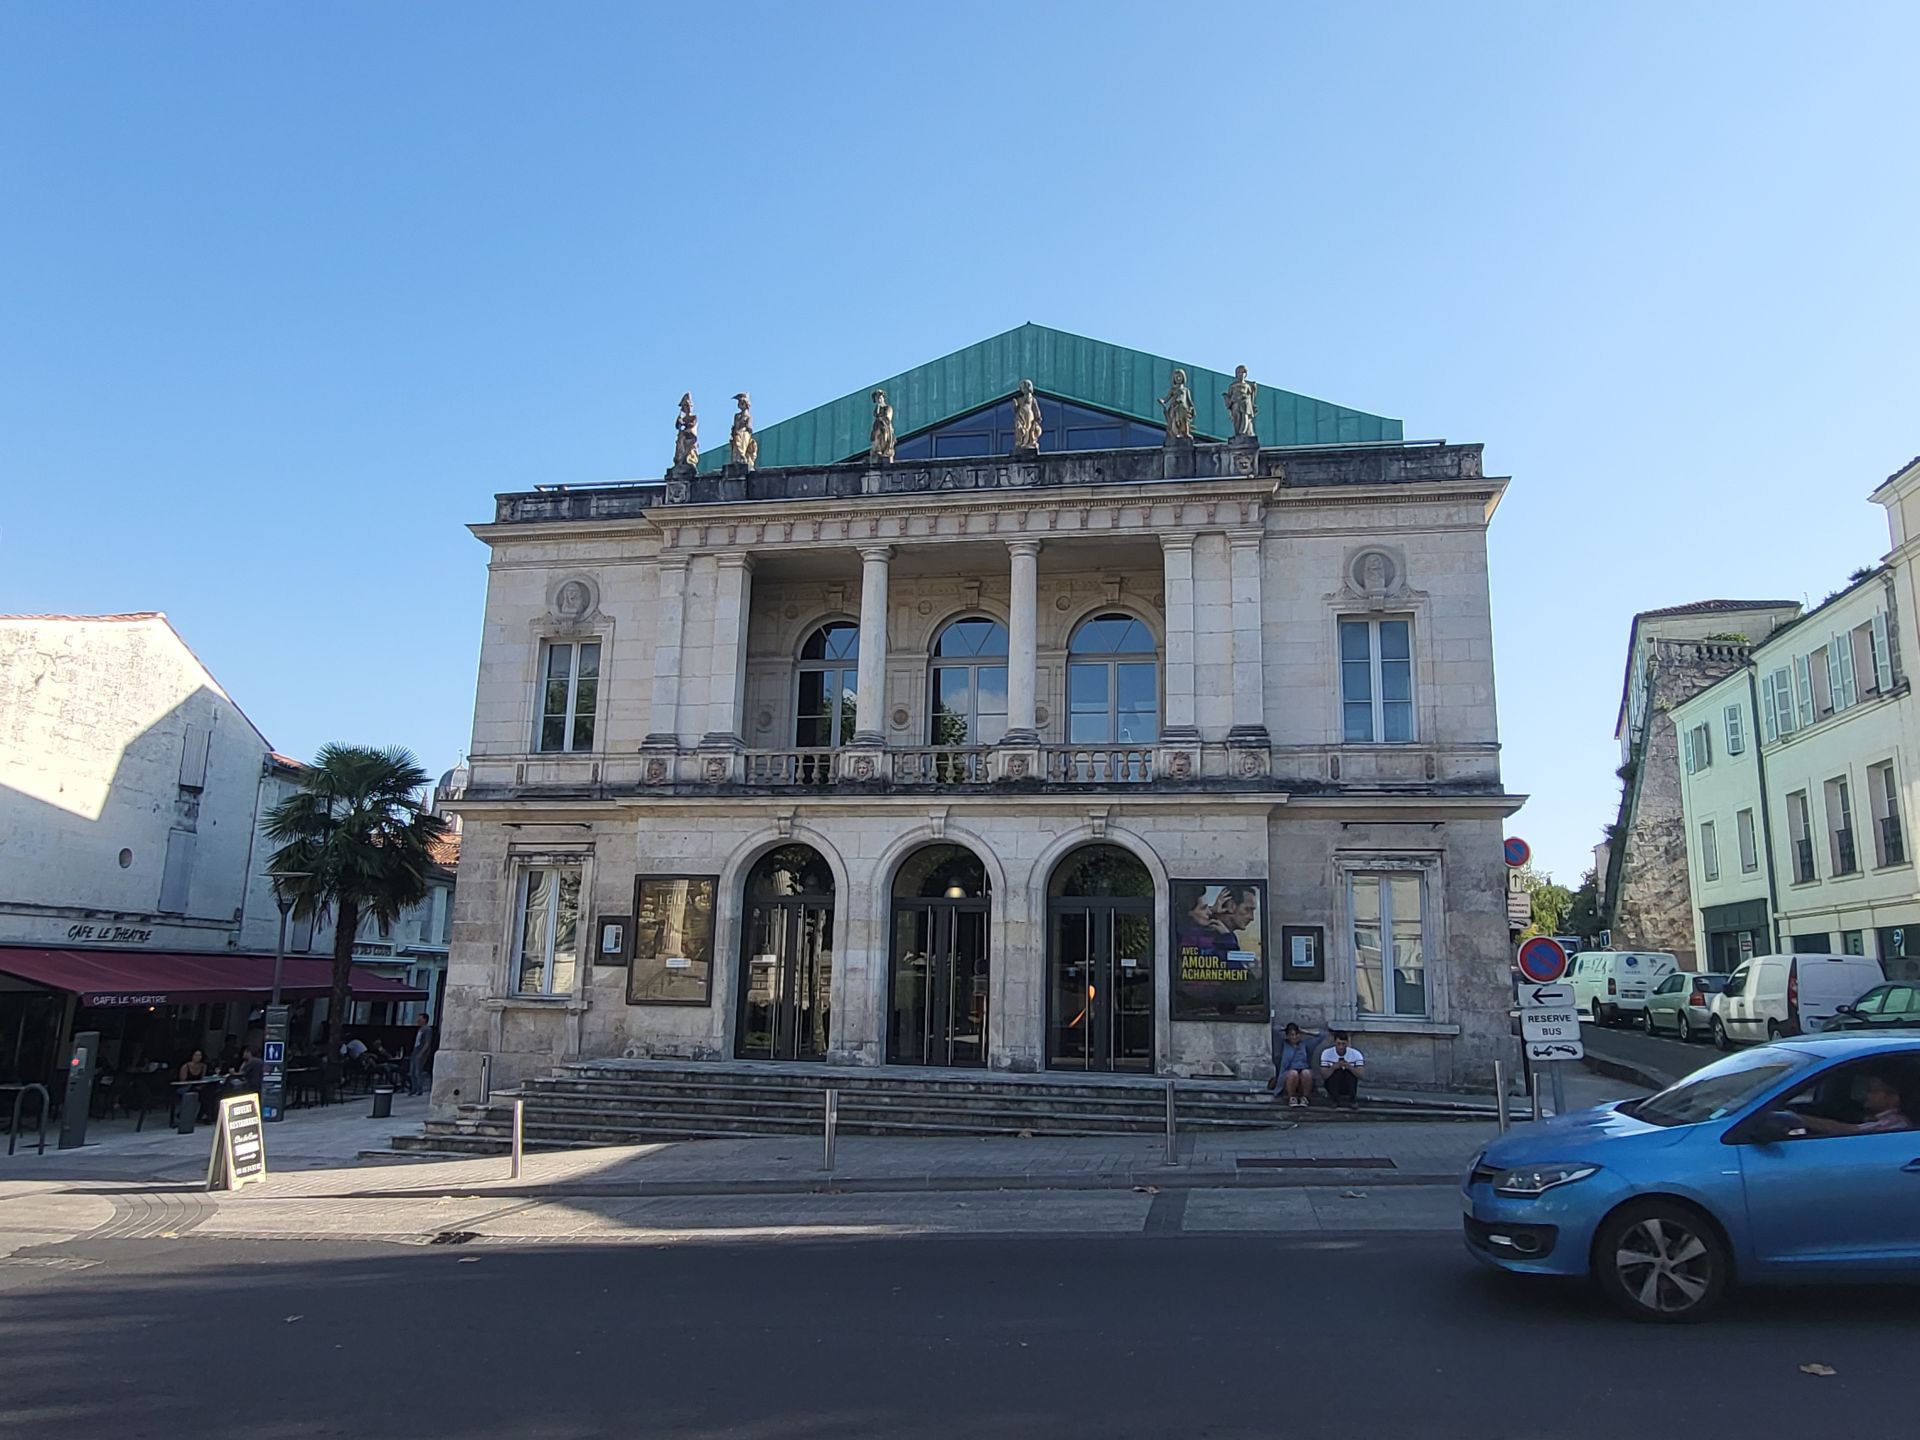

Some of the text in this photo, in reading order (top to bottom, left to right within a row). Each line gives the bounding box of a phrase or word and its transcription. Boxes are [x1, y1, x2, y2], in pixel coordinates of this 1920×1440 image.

[97, 927, 111, 939] LE
[1182, 947, 1199, 955] AVEC
[1182, 956, 1219, 968] AMOUR
[1182, 969, 1248, 981] ACHARNEMENT
[118, 996, 129, 1004] LE
[1527, 1014, 1573, 1023] RESERVE
[1542, 1027, 1562, 1036] BUS
